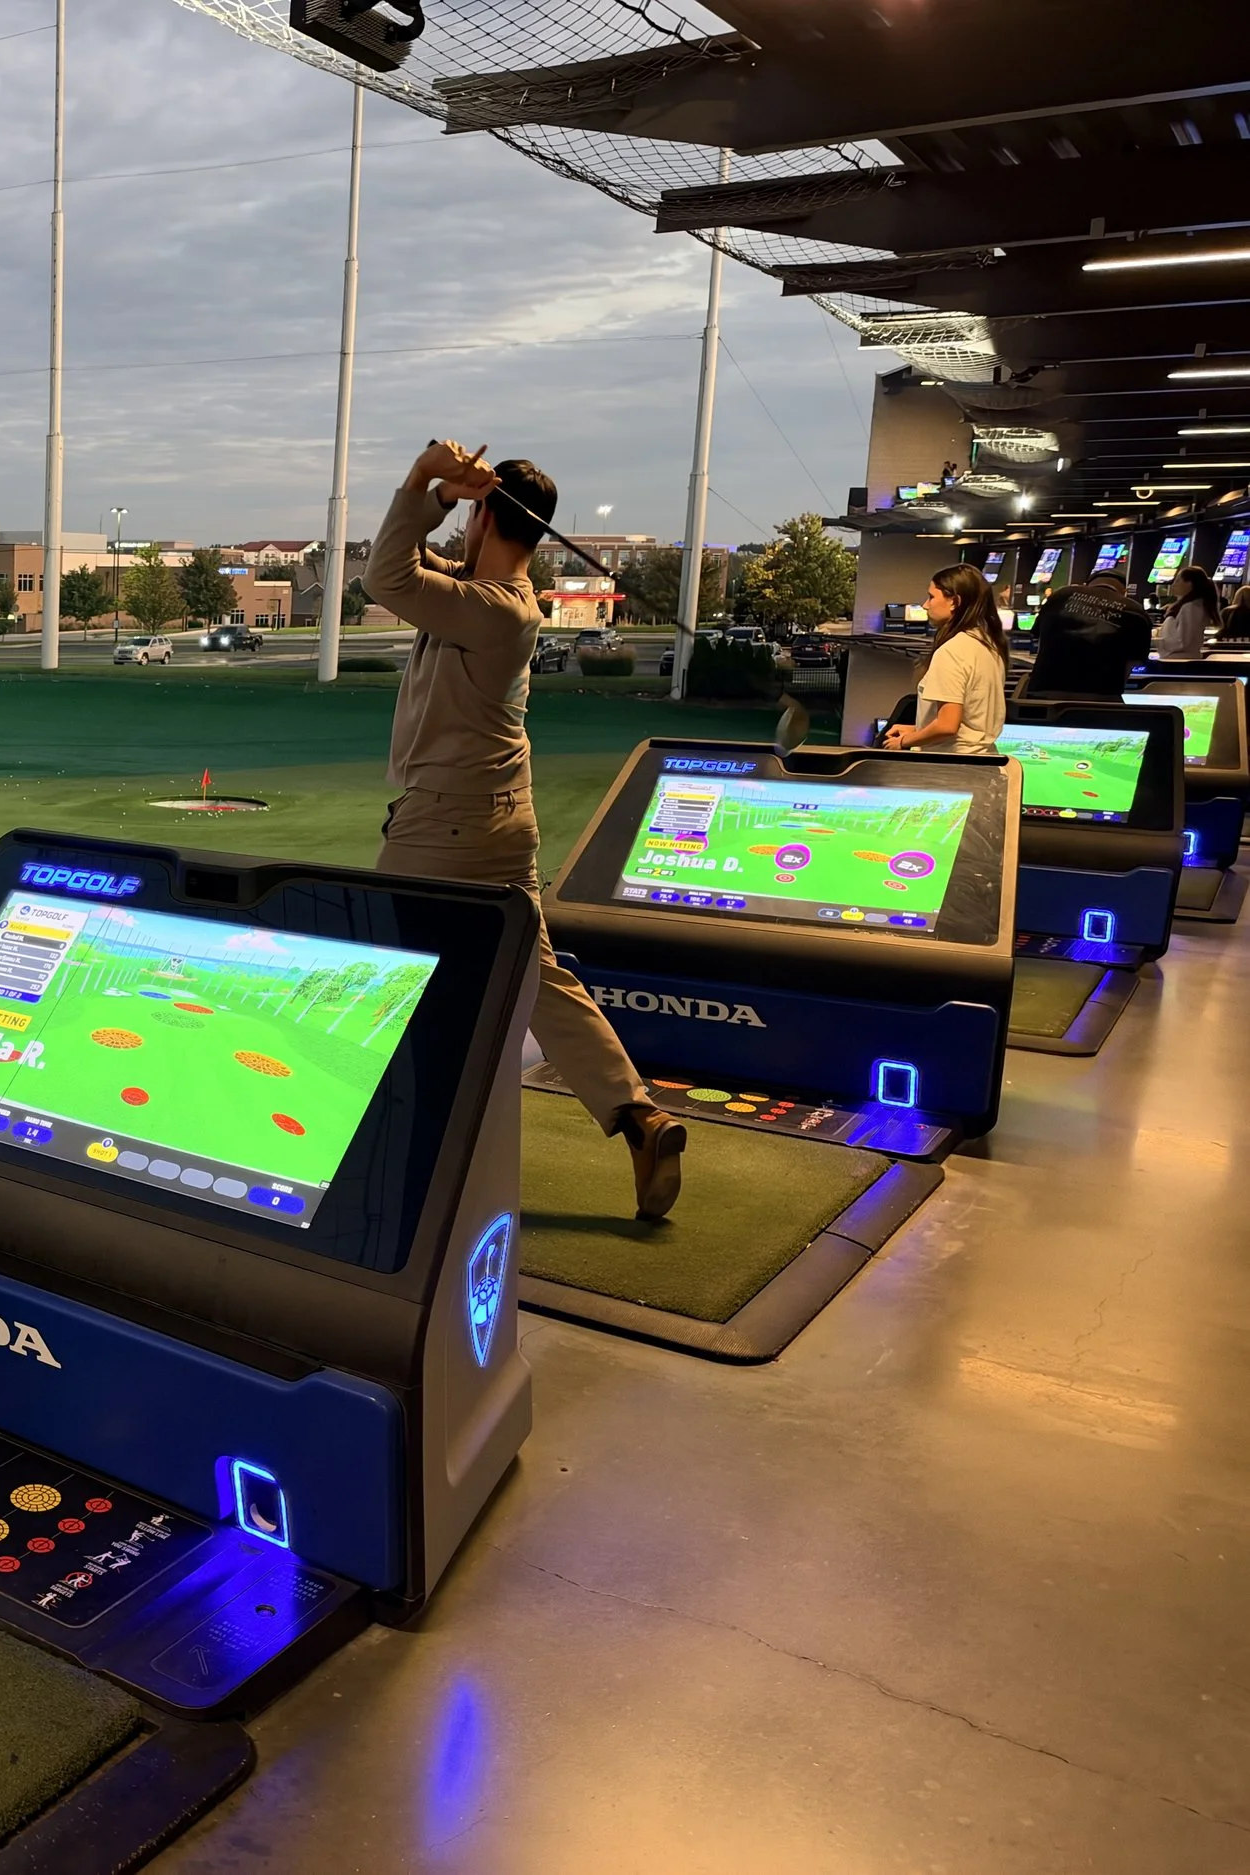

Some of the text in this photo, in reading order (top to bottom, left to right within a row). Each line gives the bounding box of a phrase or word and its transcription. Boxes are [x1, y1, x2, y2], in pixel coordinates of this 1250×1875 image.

[664, 757, 757, 773] TOPGOLF
[647, 840, 703, 850] NOW HITTING
[638, 849, 744, 873] Joshua D.
[652, 867, 662, 876] 2
[21, 864, 141, 895] TOPGOLF
[30, 909, 69, 921] TOPGOLF
[590, 985, 767, 1028] HONDA
[18, 1040, 46, 1070] R.
[26, 1127, 39, 1138] 1.4
[271, 1196, 280, 1206] 0
[135, 1523, 155, 1535] YELLOW
